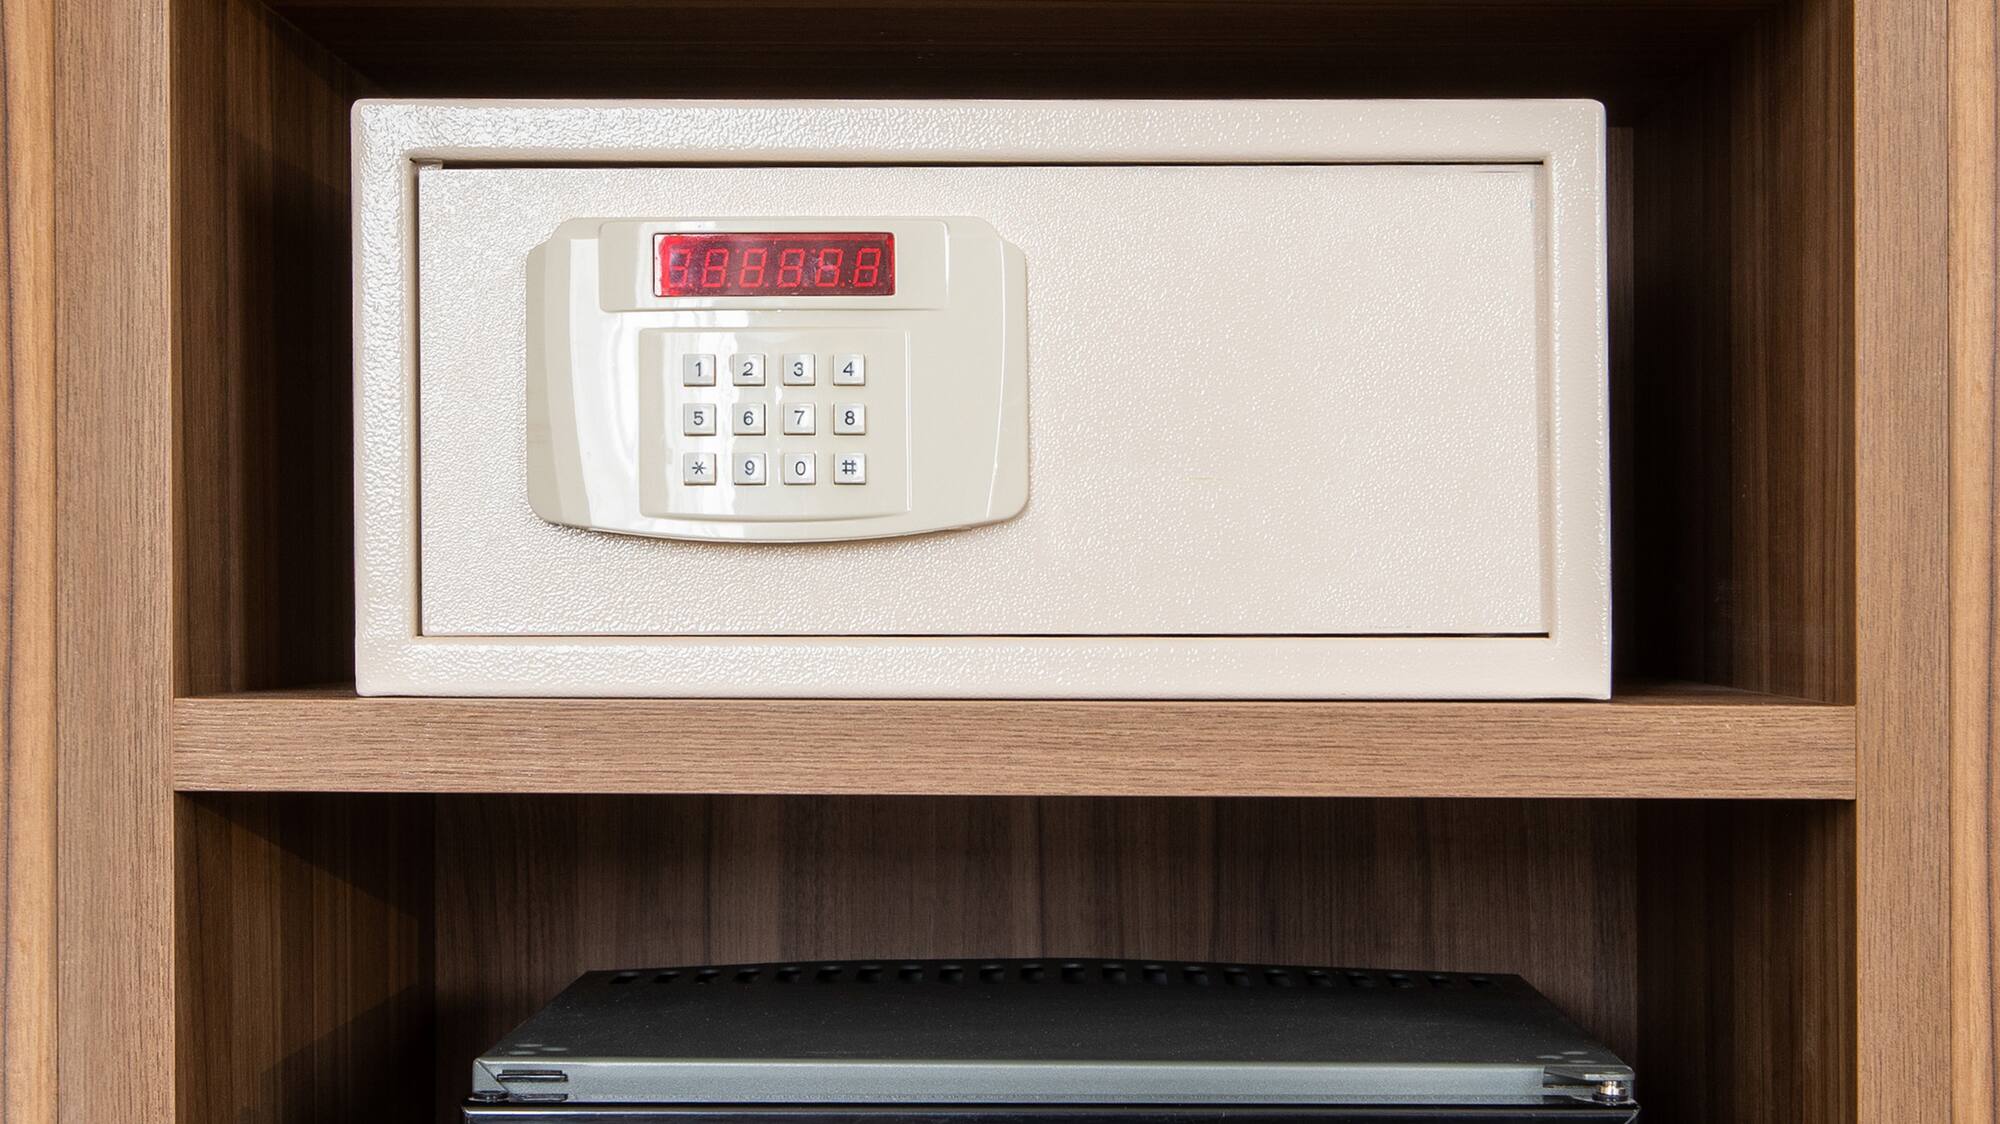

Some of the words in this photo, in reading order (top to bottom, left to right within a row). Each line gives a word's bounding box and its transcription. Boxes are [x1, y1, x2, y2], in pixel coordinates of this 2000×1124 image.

[695, 361, 702, 377] 1
[742, 361, 753, 377] 2
[793, 361, 804, 377] 3
[842, 362, 854, 377] 4
[693, 410, 704, 426] 5
[743, 410, 754, 426] 6
[793, 409, 805, 425] 7
[844, 410, 855, 426] 8
[744, 460, 755, 476] 9
[795, 460, 806, 476] 0
[841, 459, 857, 475] #
